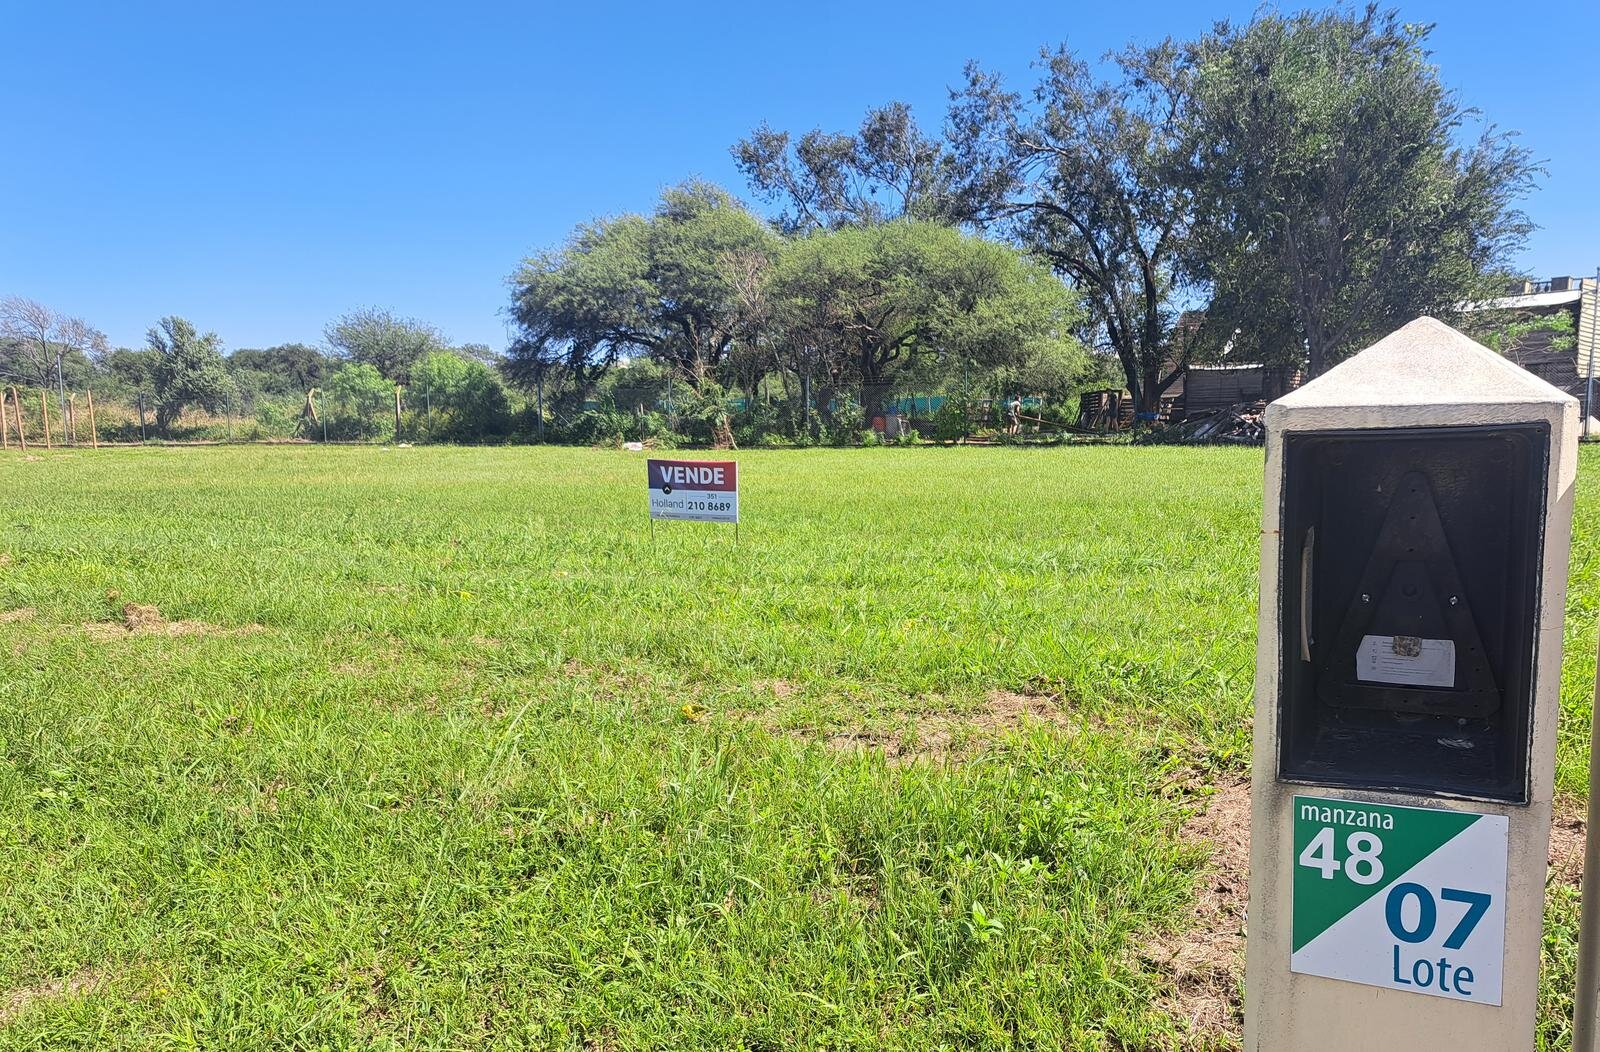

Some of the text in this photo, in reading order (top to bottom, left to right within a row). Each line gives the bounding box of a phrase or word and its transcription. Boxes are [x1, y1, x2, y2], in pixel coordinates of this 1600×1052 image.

[660, 466, 724, 484] VENDE
[652, 499, 684, 508] Holland
[688, 501, 731, 511] 210 8689
[1301, 804, 1394, 830] manzana
[1299, 827, 1384, 885] 48
[1385, 882, 1492, 950] 07
[1393, 944, 1474, 995] Lote
